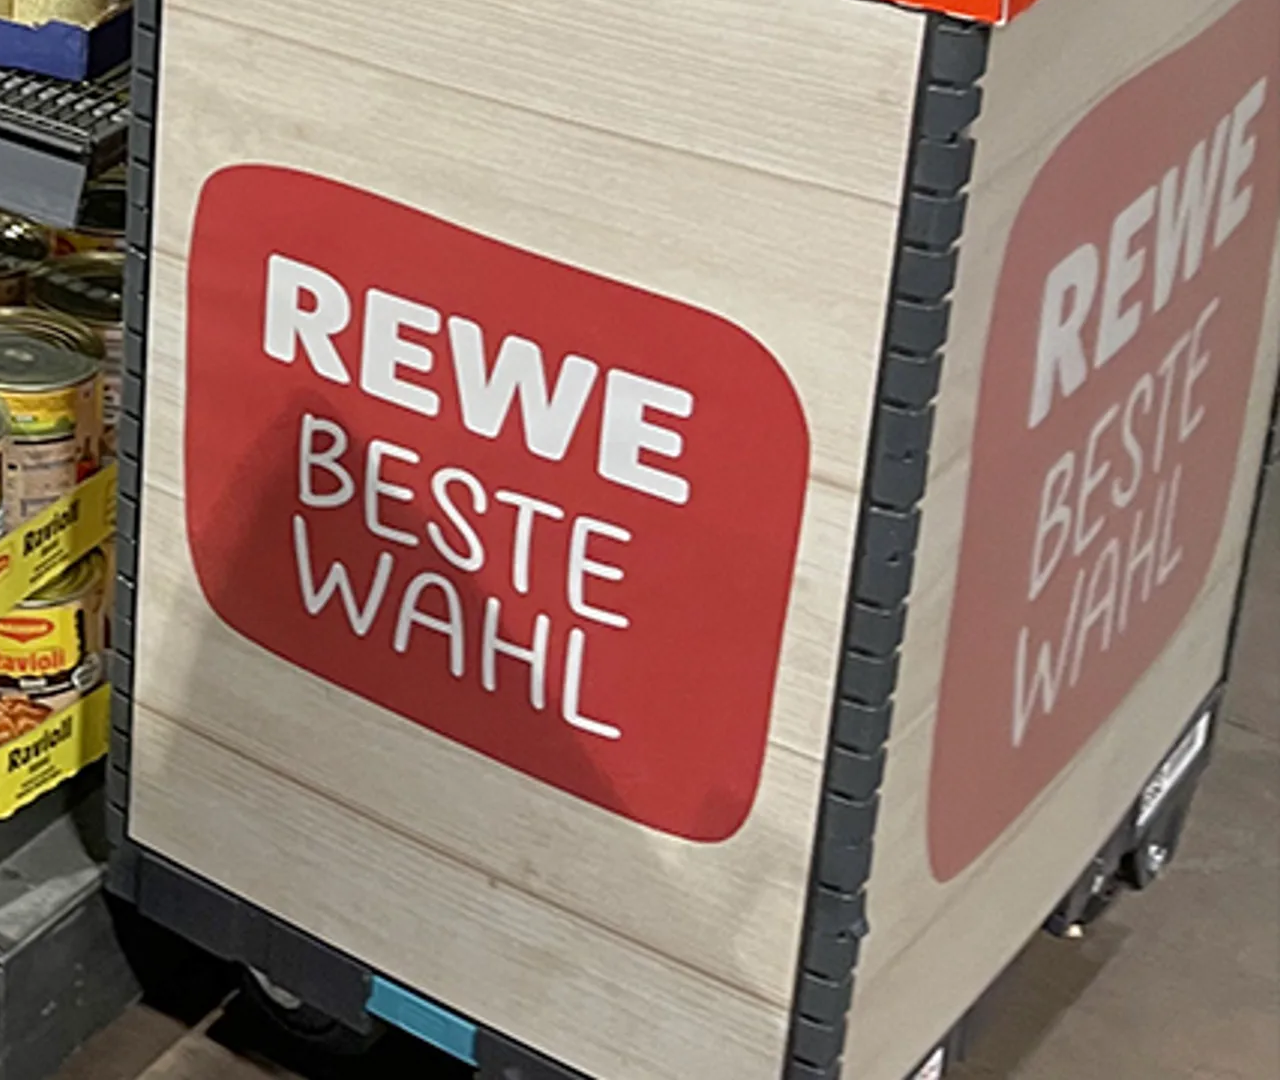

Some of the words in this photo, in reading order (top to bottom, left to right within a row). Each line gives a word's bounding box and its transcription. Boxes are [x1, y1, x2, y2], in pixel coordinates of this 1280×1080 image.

[1028, 76, 1268, 429] REWE
[262, 254, 696, 505] REWE
[1028, 297, 1221, 602] BESTE
[292, 514, 621, 740] WAHL
[298, 414, 633, 629] BESTE
[1012, 466, 1184, 748] WAHL
[7, 716, 73, 773] Ravioli
